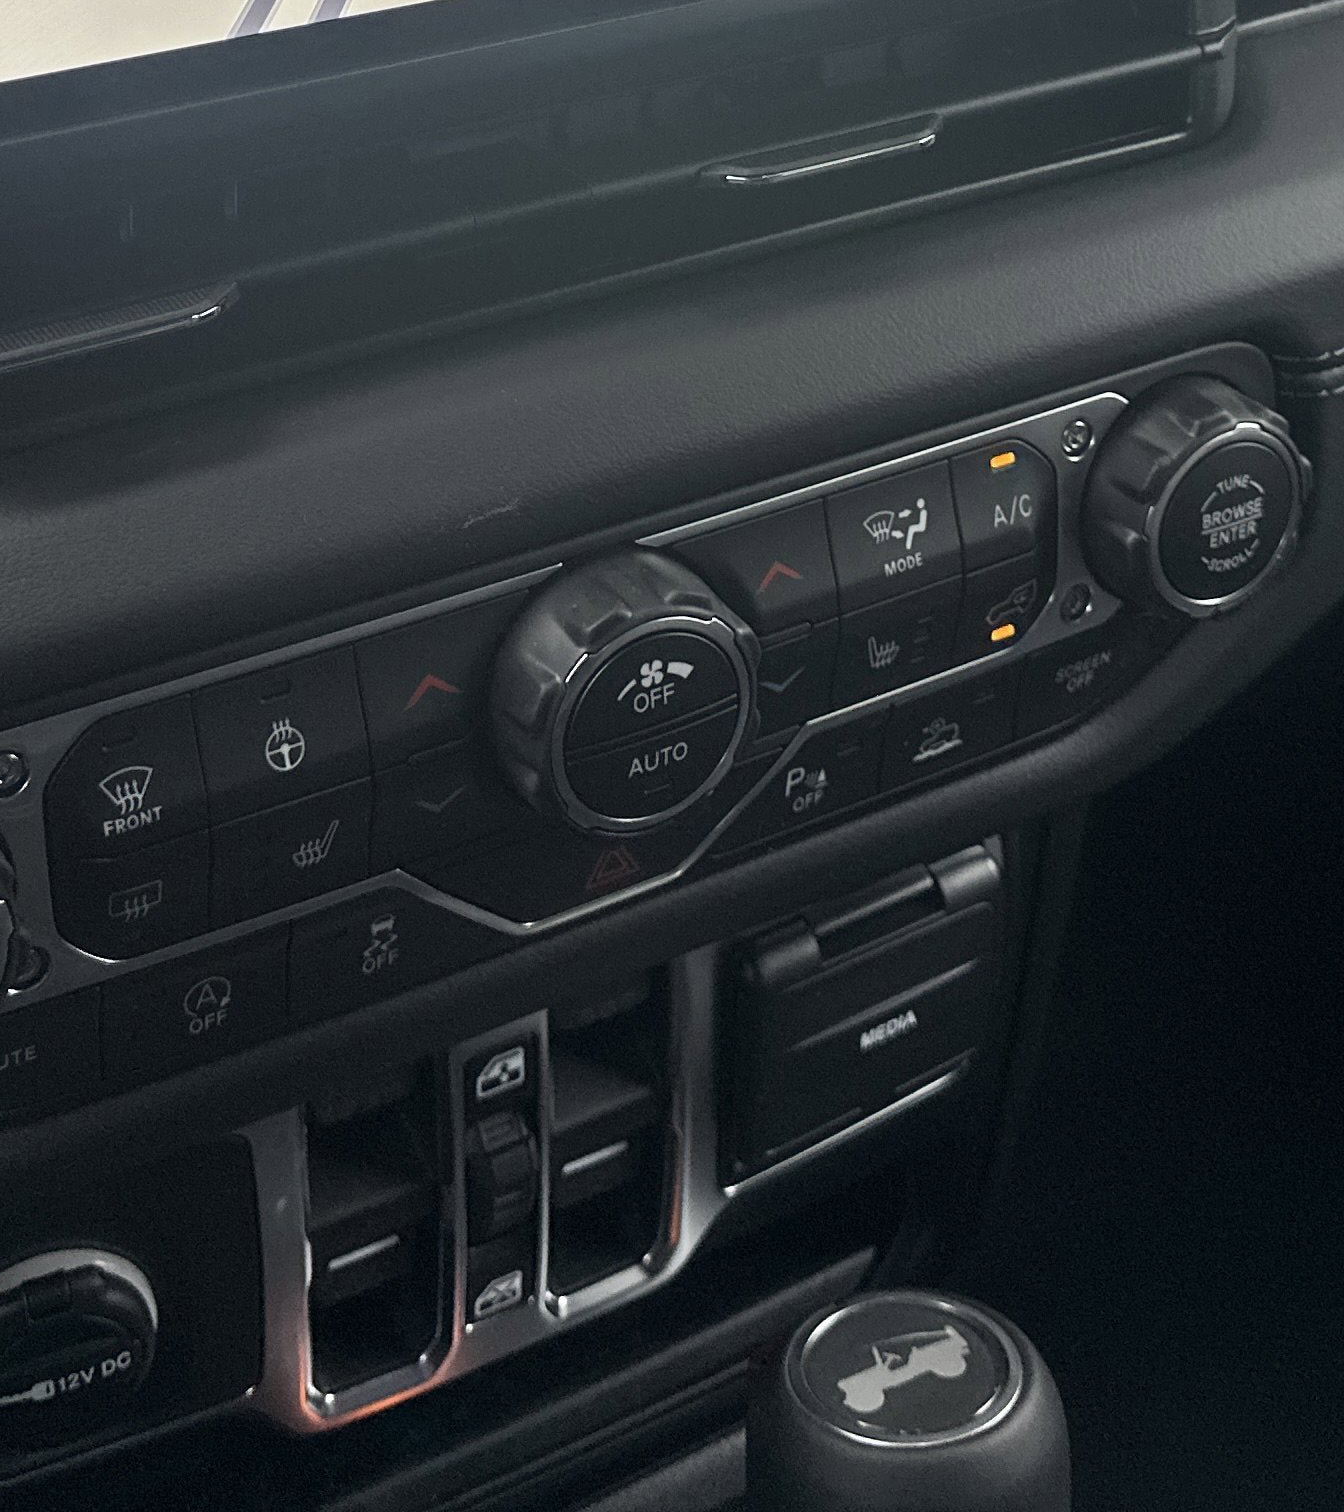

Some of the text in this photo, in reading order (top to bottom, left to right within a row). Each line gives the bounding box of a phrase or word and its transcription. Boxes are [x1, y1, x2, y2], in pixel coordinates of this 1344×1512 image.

[1216, 474, 1250, 494] TUNE
[994, 494, 1032, 528] A/C
[1202, 496, 1263, 529] BROWSE
[1210, 520, 1256, 548] ENTER
[884, 552, 923, 577] MODE
[1207, 548, 1253, 571] SCROLL
[633, 683, 675, 714] OFF
[628, 741, 688, 779] AUTO
[785, 767, 805, 797] P
[793, 789, 824, 813] OFF
[103, 805, 162, 836] FRONT
[362, 948, 399, 974] OFF
[189, 1009, 229, 1034] OFF
[860, 1010, 918, 1050] MEDIA
[58, 1351, 132, 1392] 12V DC
